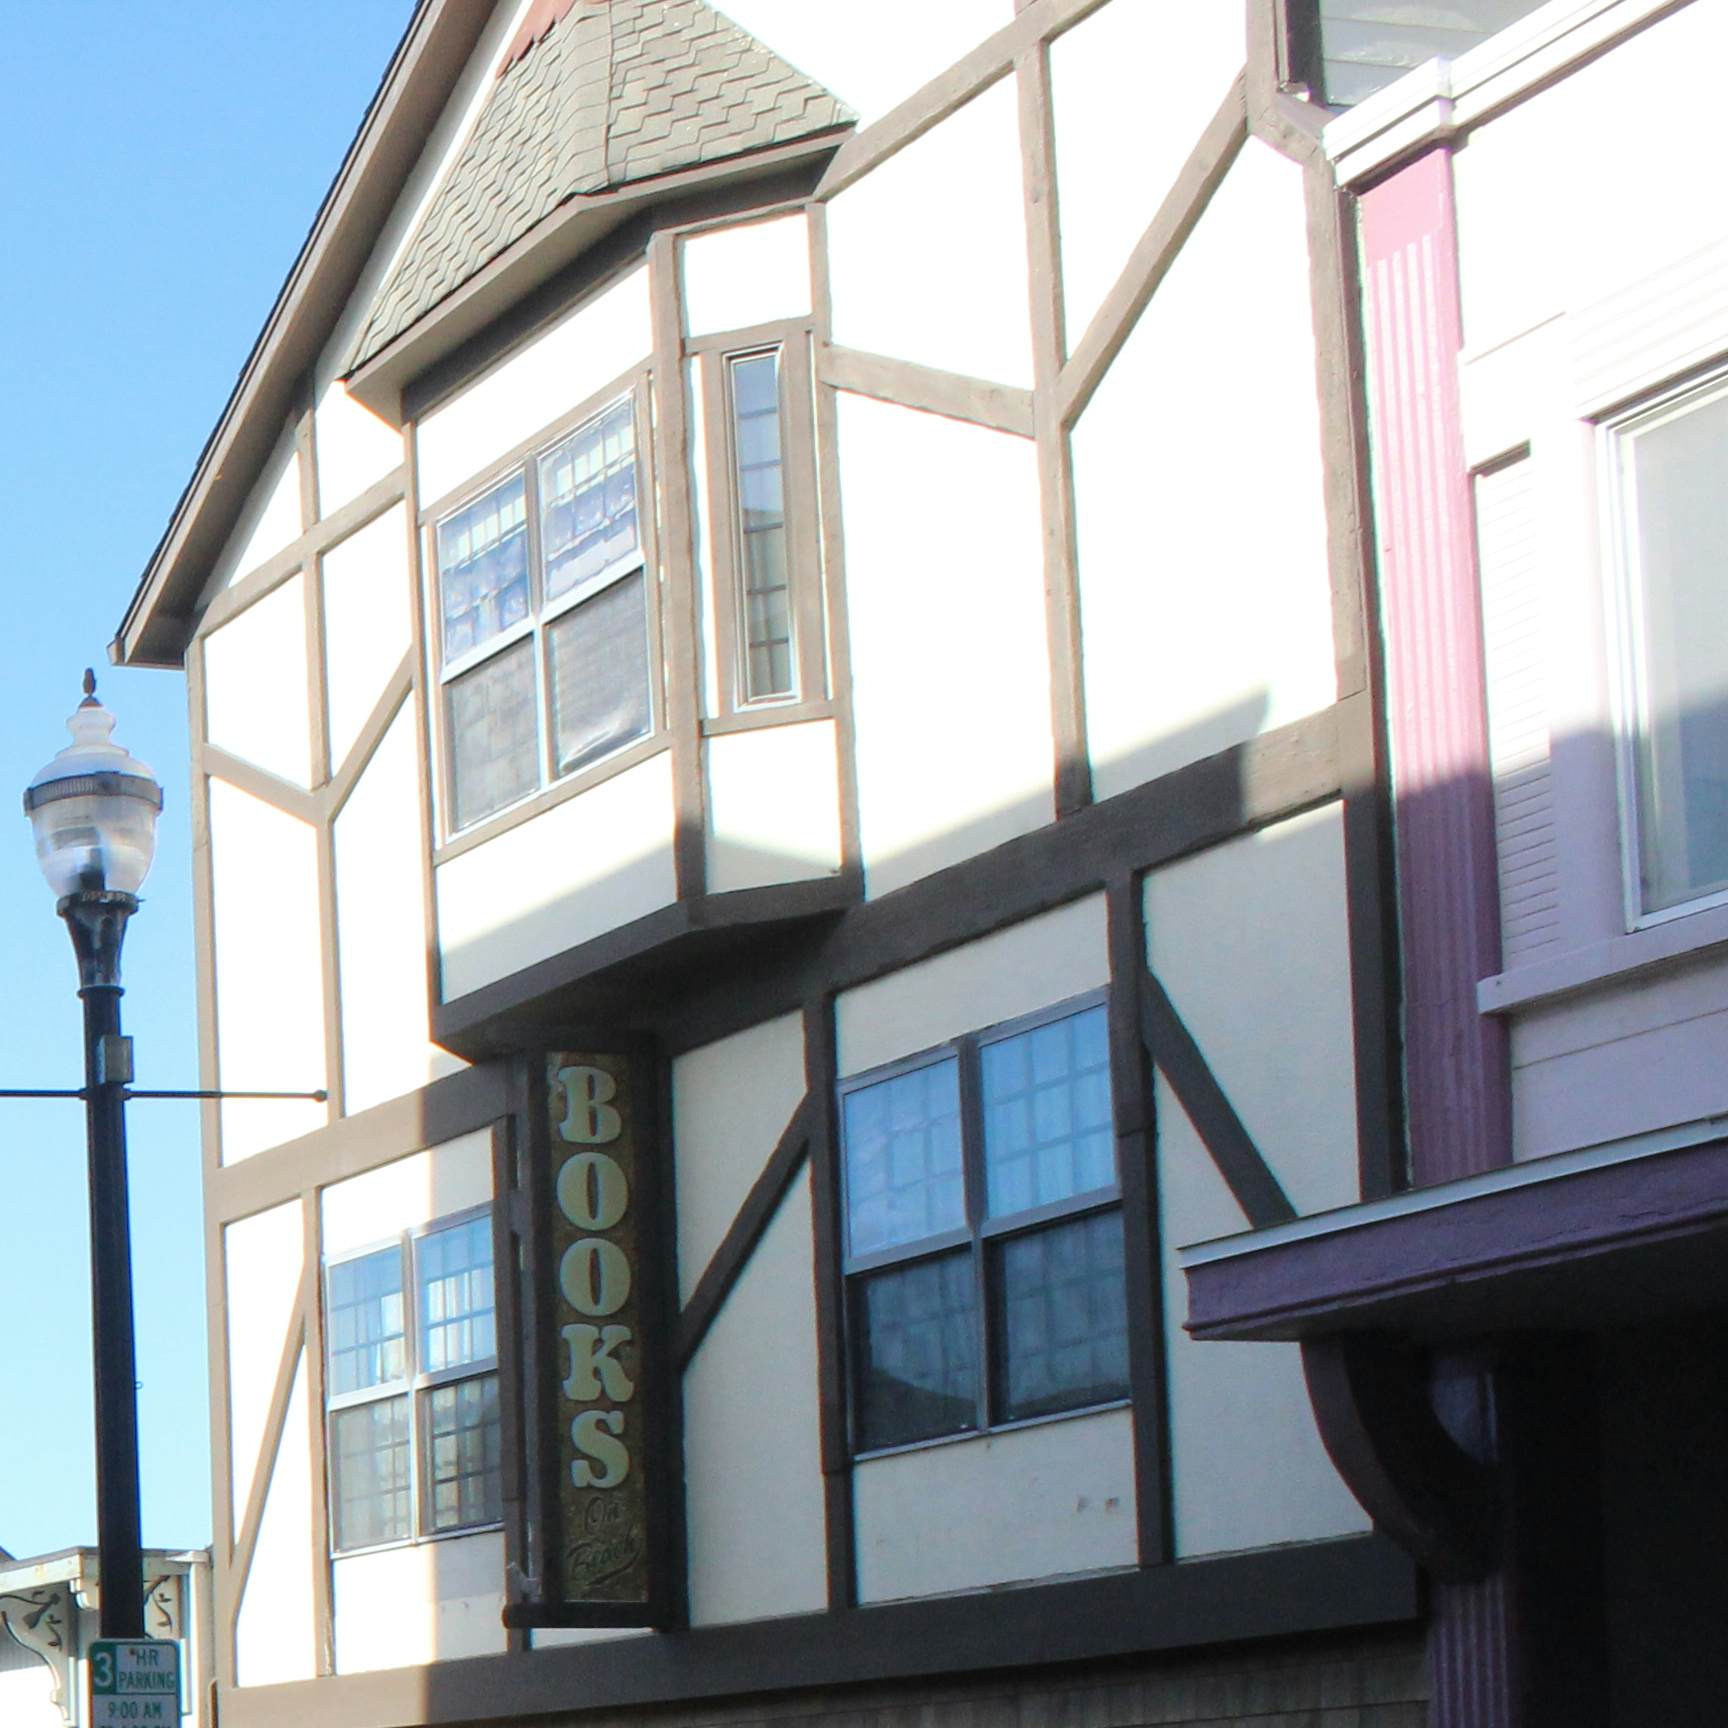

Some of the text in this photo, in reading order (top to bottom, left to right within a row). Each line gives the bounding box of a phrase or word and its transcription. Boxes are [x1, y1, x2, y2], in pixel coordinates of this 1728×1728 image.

[556, 1065, 634, 1489] BOOKS
[95, 1649, 158, 1687] 3 HR
[119, 1672, 175, 1689] PARKING
[108, 1702, 162, 1718] 9:00 AM
